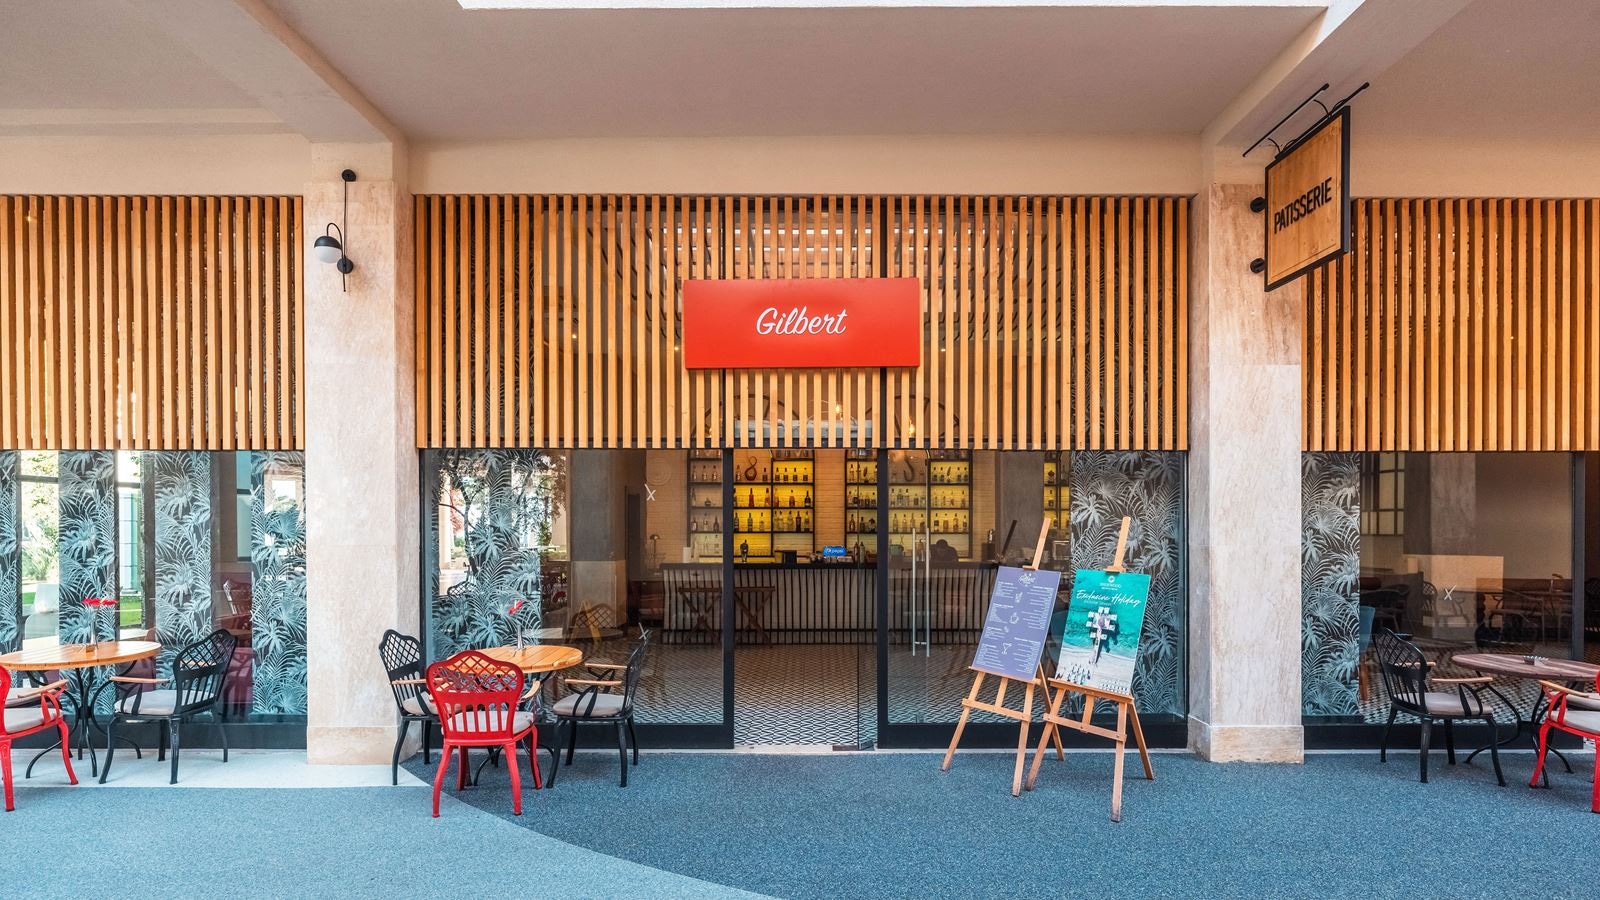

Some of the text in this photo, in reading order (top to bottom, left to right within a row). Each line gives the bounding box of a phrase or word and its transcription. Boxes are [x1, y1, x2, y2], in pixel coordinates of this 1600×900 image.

[1274, 177, 1333, 234] PATISSERIE
[756, 306, 848, 335] Gilbert
[1076, 589, 1110, 601] Exclusive
[1111, 594, 1142, 607] Holiday
